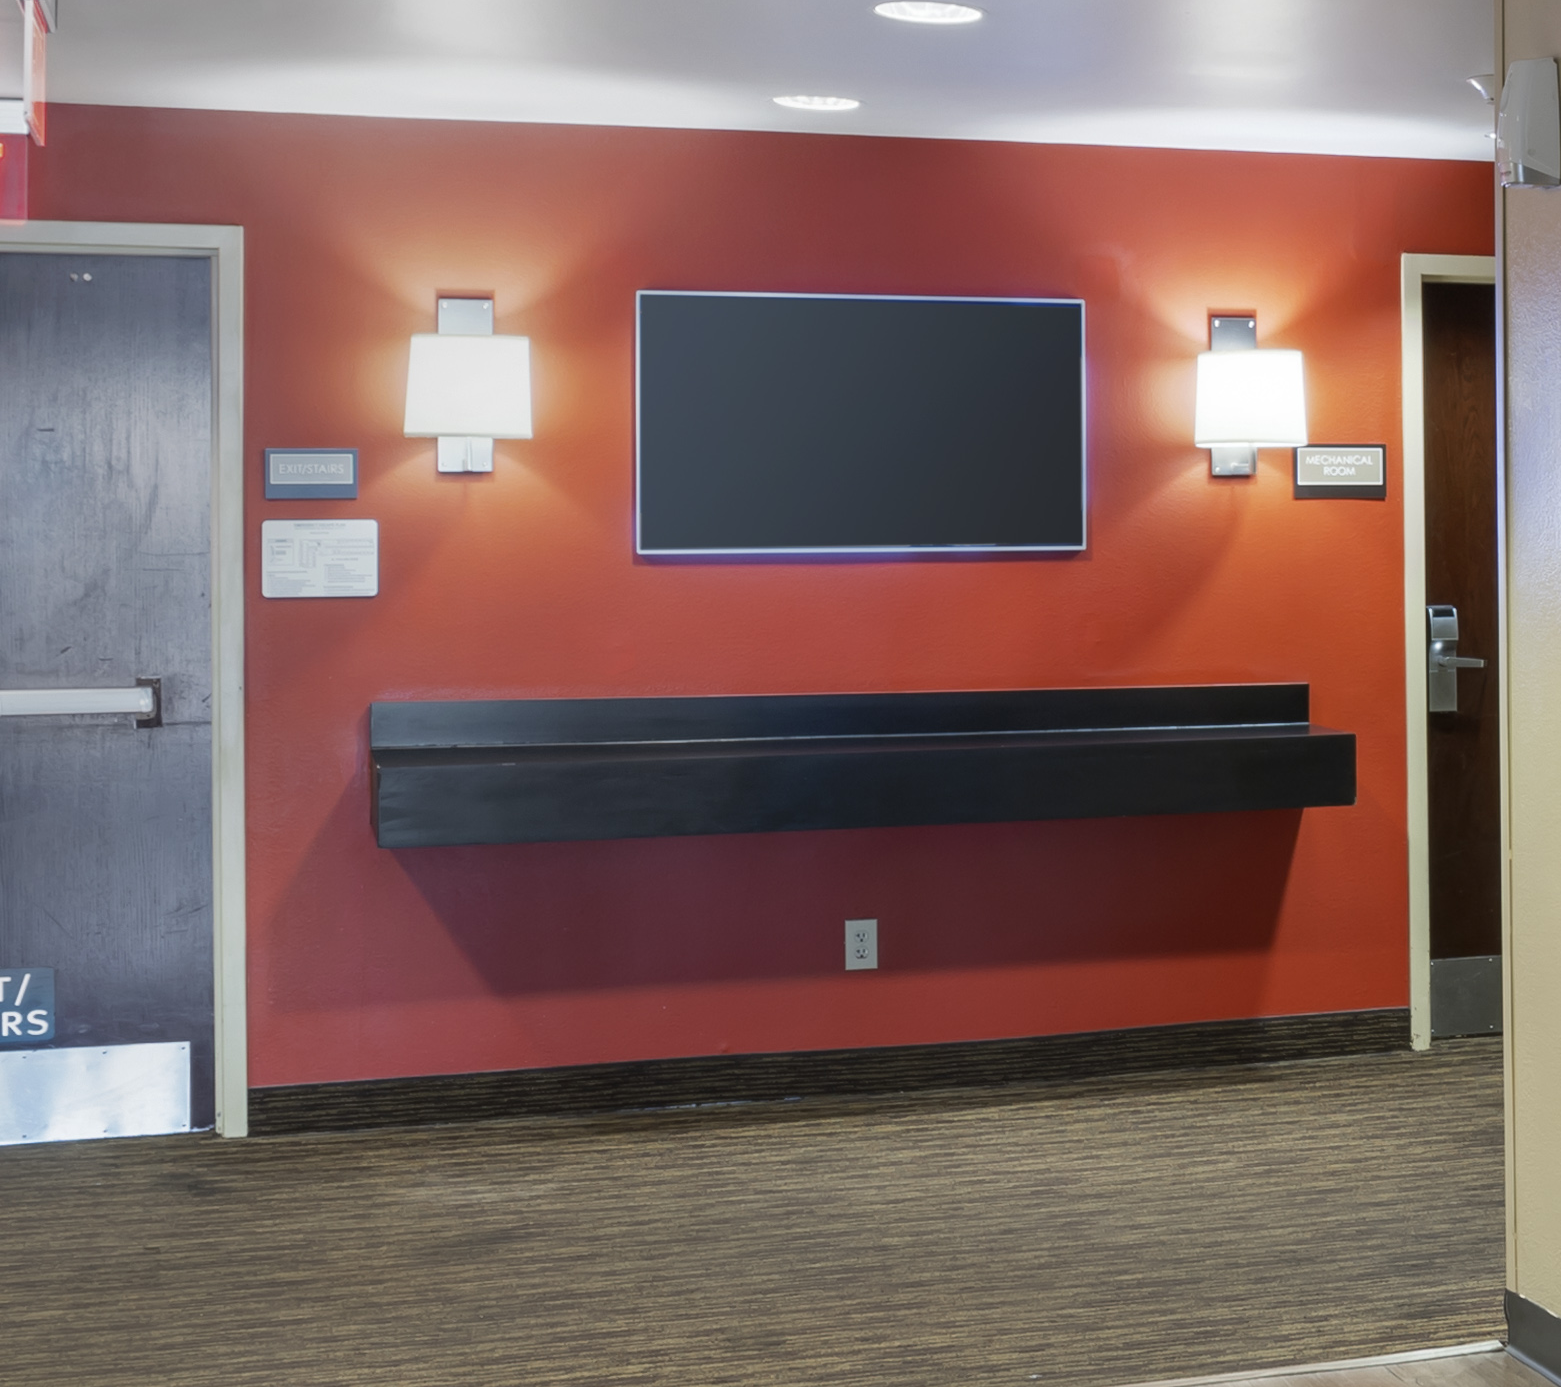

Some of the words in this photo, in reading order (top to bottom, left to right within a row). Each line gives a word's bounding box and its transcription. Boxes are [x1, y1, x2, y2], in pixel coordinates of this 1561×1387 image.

[1305, 455, 1373, 465] MECHANICAL
[279, 463, 344, 475] EXIT/STAIRS
[1323, 466, 1356, 476] ROOM
